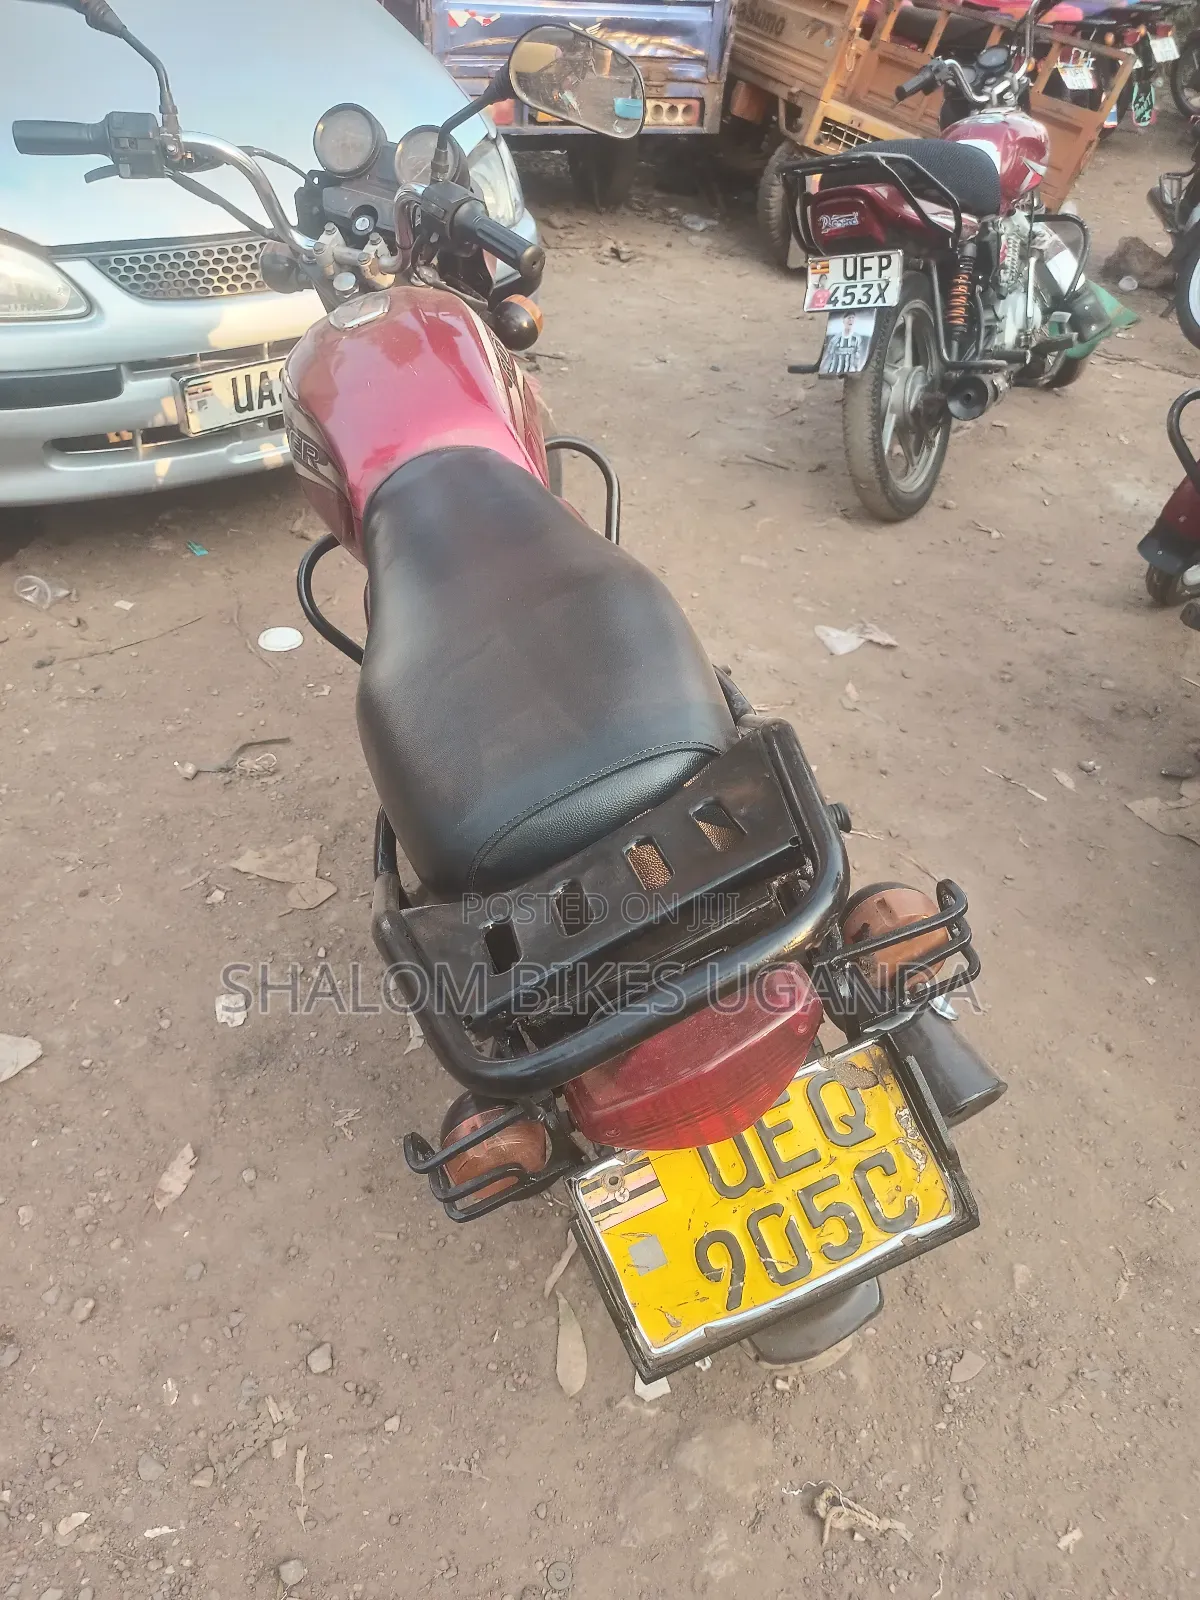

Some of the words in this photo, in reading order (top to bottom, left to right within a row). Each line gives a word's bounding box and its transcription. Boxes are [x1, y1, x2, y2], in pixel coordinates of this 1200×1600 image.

[842, 255, 892, 281] UFP
[827, 282, 890, 308] 453X
[231, 367, 284, 413] UA
[286, 427, 321, 472] ER
[696, 1072, 878, 1201] UEQ
[694, 1149, 921, 1312] 905C
